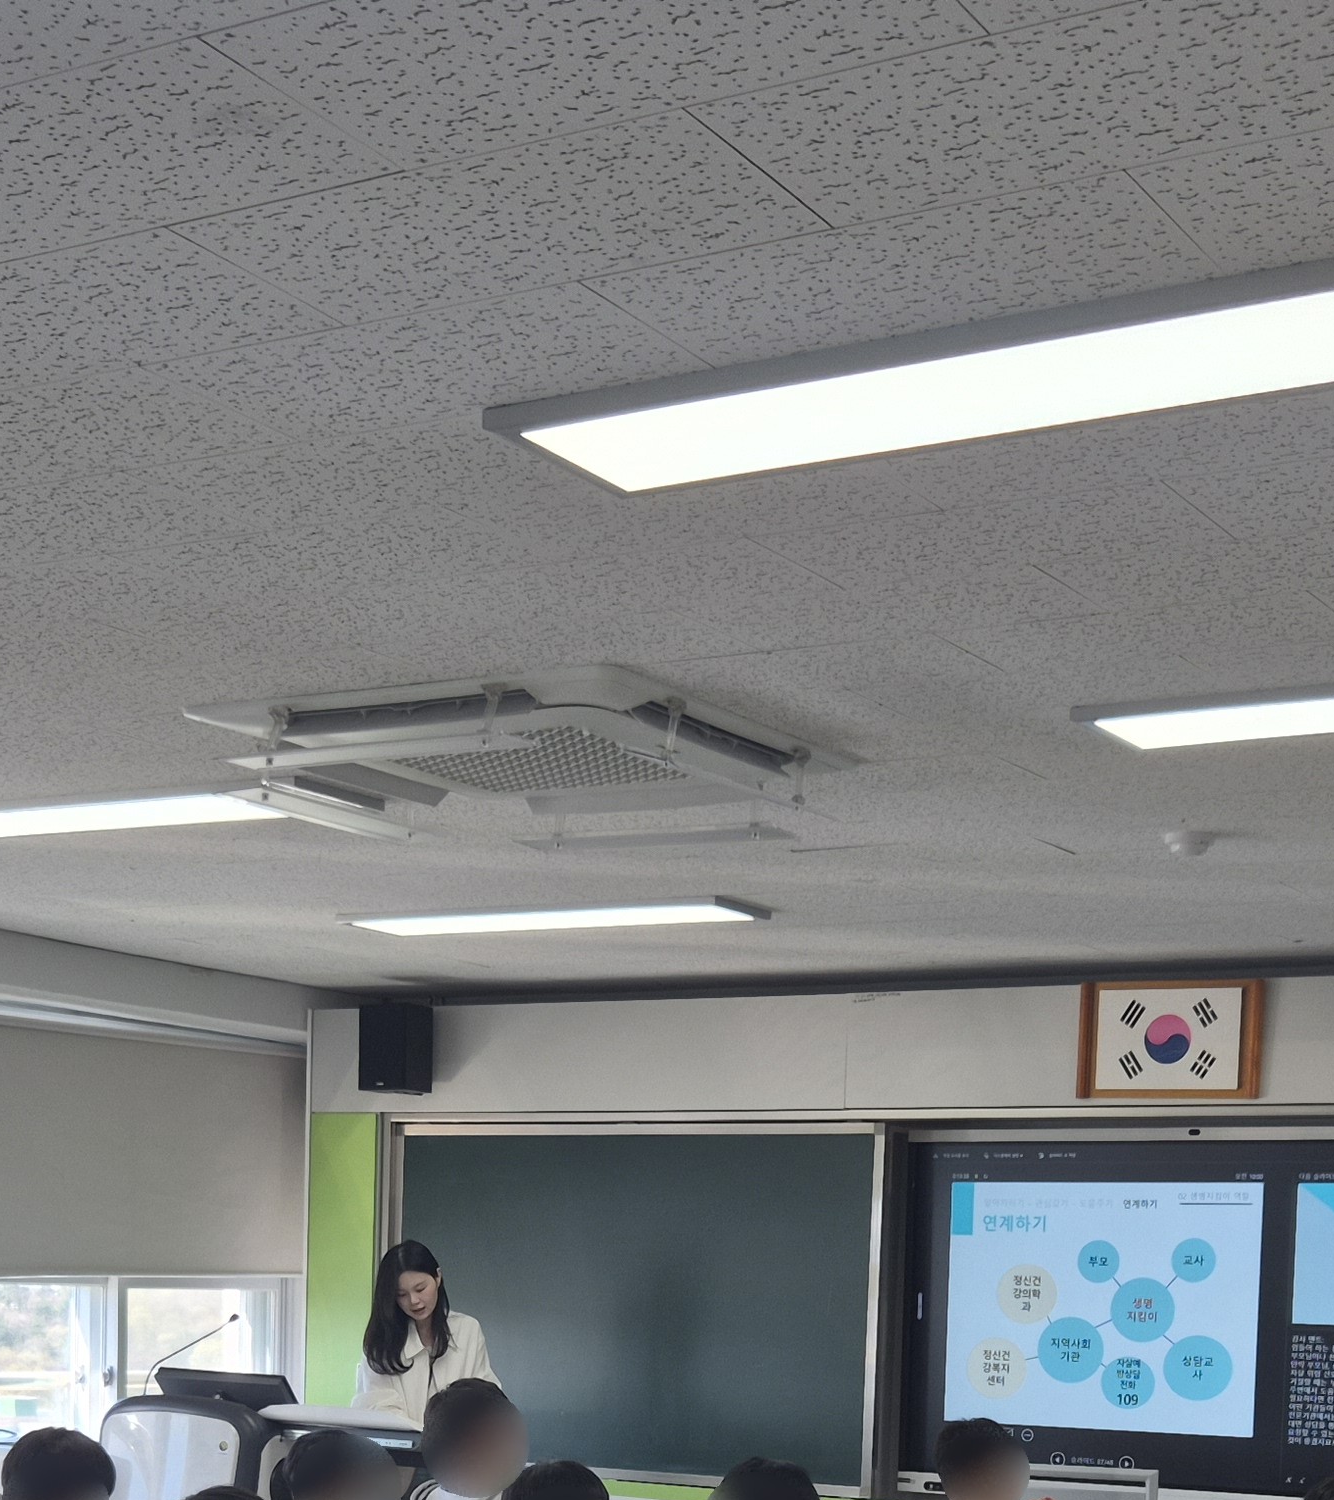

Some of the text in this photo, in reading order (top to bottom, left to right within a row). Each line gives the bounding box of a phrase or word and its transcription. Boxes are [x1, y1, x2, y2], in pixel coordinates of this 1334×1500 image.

[1123, 1199, 1158, 1209] 연계하기
[983, 1215, 1047, 1233] 연계하기
[1088, 1256, 1108, 1267] 부모
[1183, 1255, 1204, 1266] 교사
[1013, 1275, 1042, 1286] 정신건
[1013, 1288, 1041, 1299] 강의학
[1022, 1301, 1032, 1312] 과
[1133, 1298, 1153, 1309] 생명
[1126, 1311, 1158, 1323] 지킴이
[1051, 1338, 1091, 1350] 지역사회
[983, 1350, 1011, 1361] 정신건
[1060, 1352, 1080, 1363] 기관
[1117, 1358, 1141, 1368] 자살예
[1182, 1356, 1214, 1368] 상담교
[982, 1363, 1010, 1374] 강복지
[986, 1375, 1005, 1387] 센터
[1192, 1370, 1203, 1381] 사
[1120, 1380, 1136, 1390] 전화
[1117, 1394, 1138, 1406] 109
